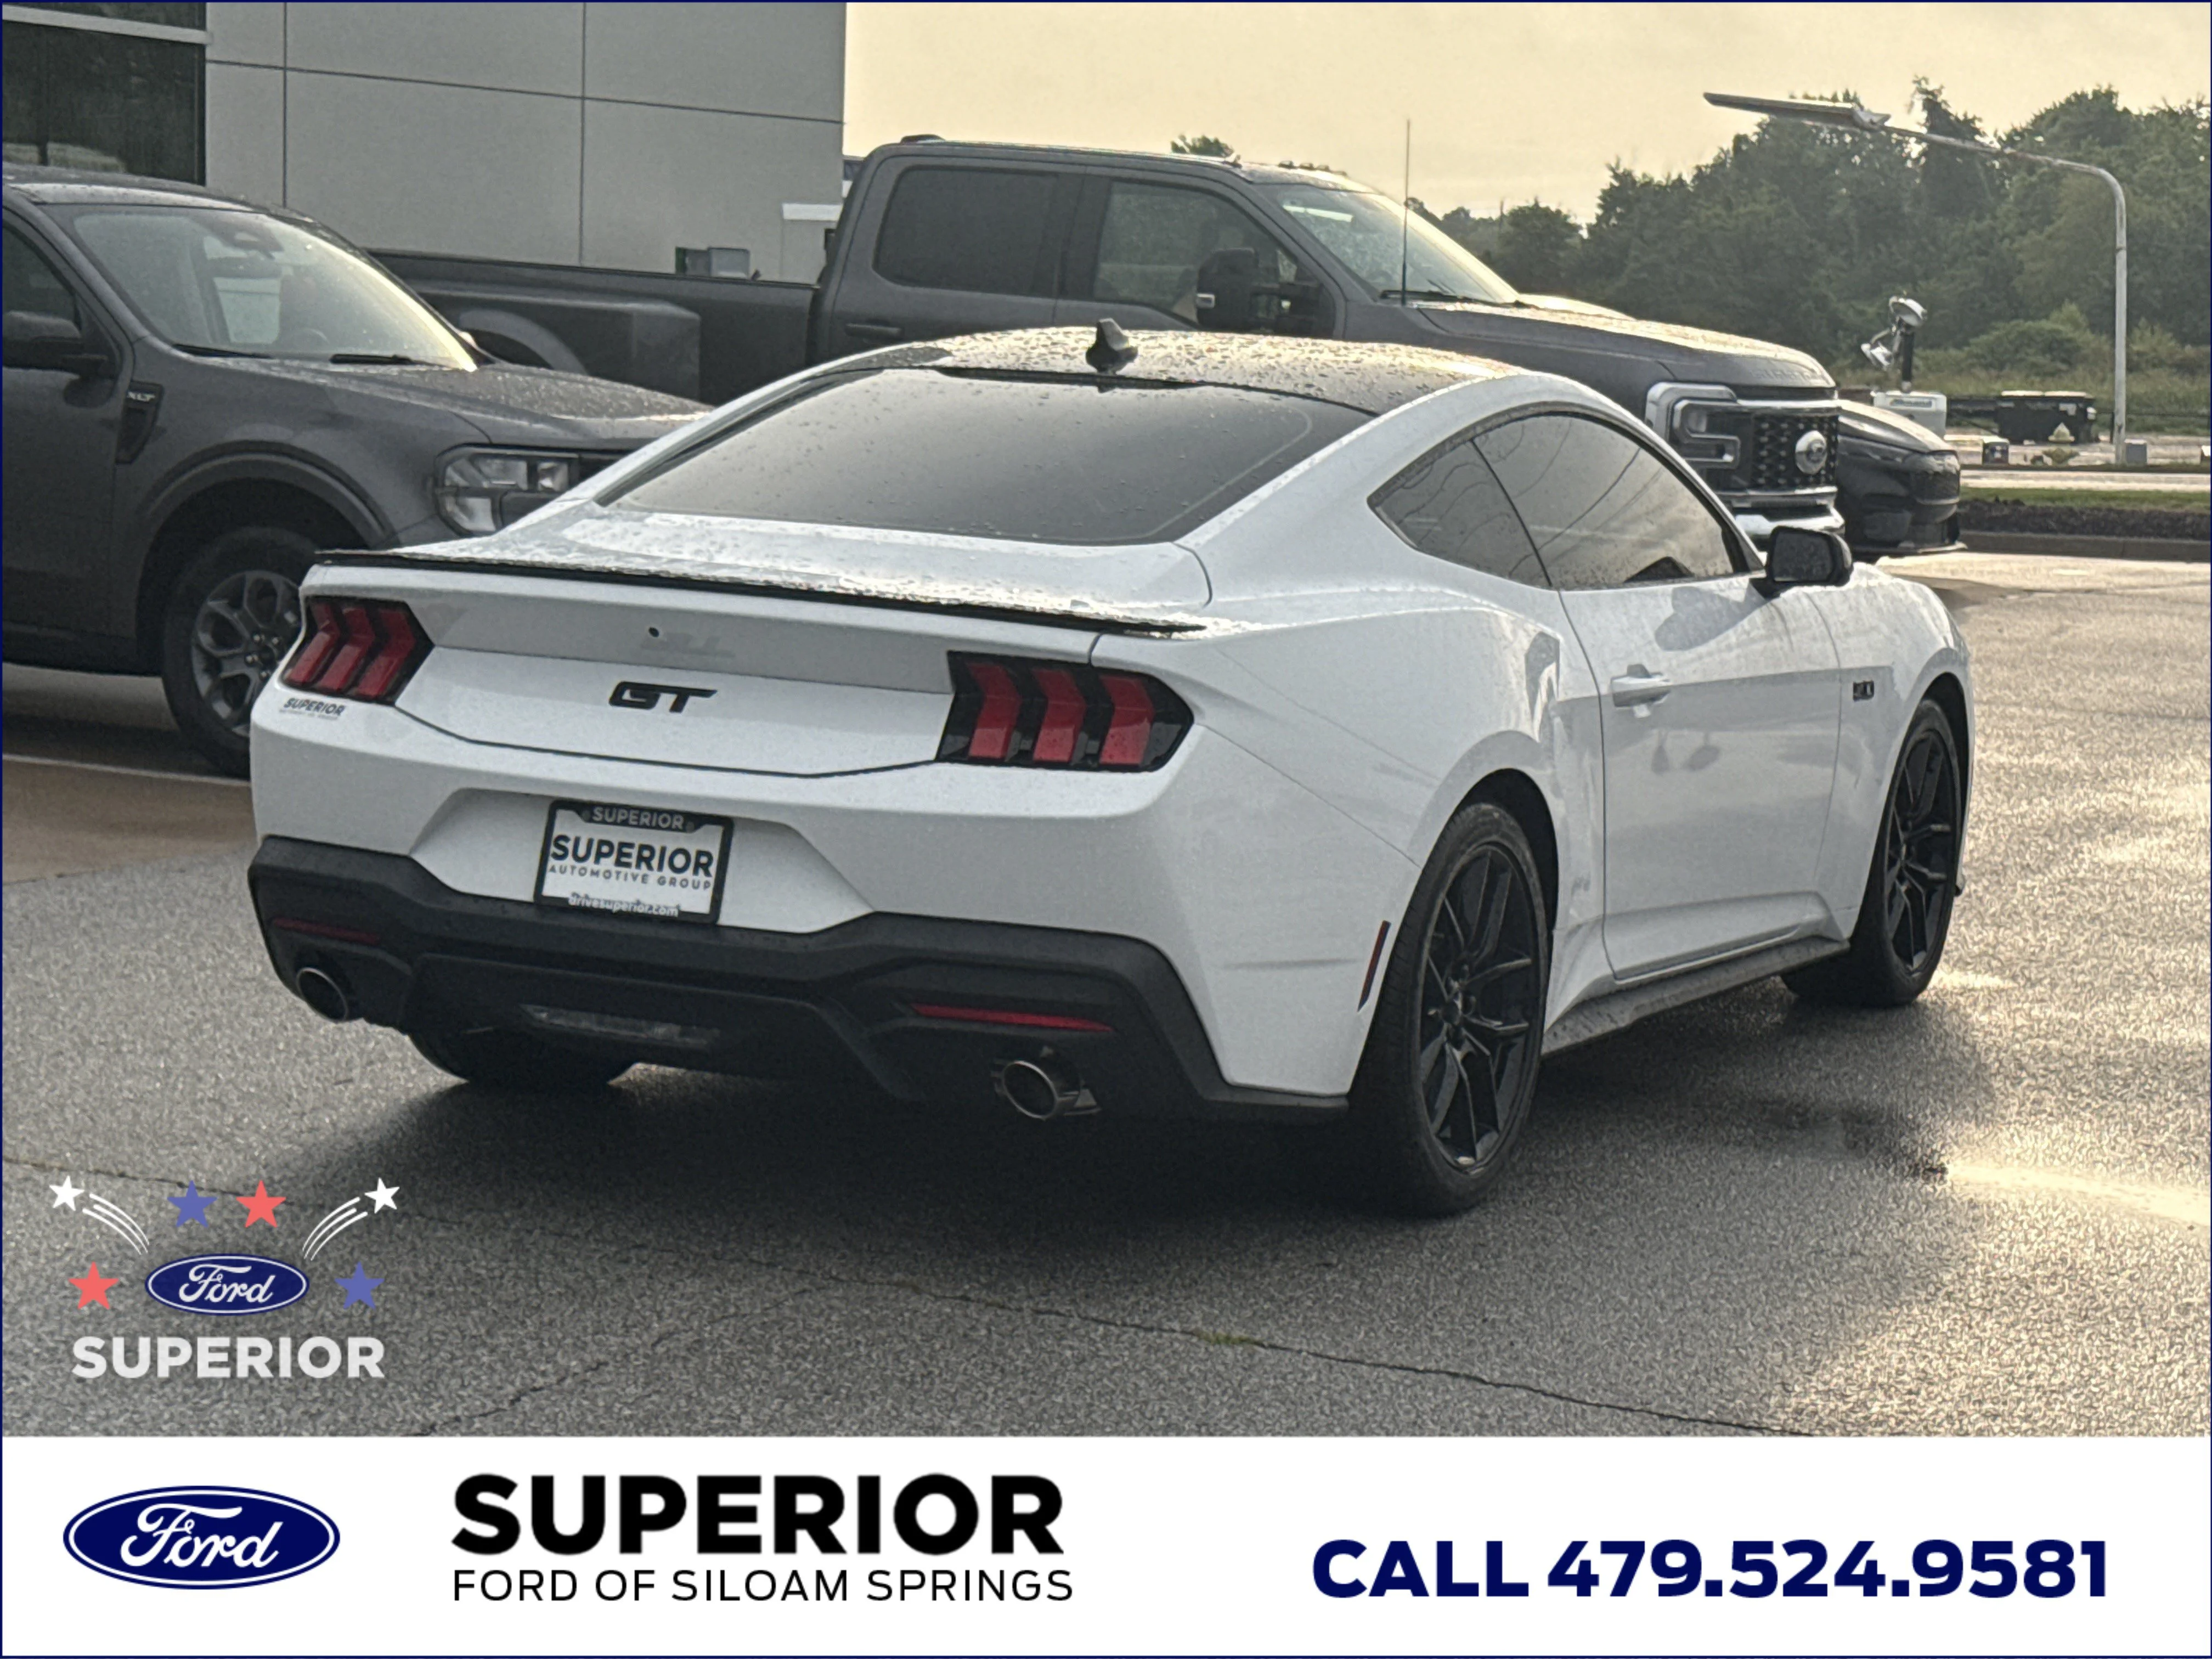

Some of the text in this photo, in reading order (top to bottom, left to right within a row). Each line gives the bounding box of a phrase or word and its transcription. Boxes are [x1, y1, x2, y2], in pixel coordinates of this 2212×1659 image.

[283, 697, 346, 716] SUPERIOR
[608, 681, 718, 713] GT
[592, 806, 685, 830] SUPERIOR
[550, 834, 714, 878] SUPERIOR
[549, 864, 712, 891] AUTOMOTIVE GROUP
[568, 892, 680, 918] drivesuperior.com
